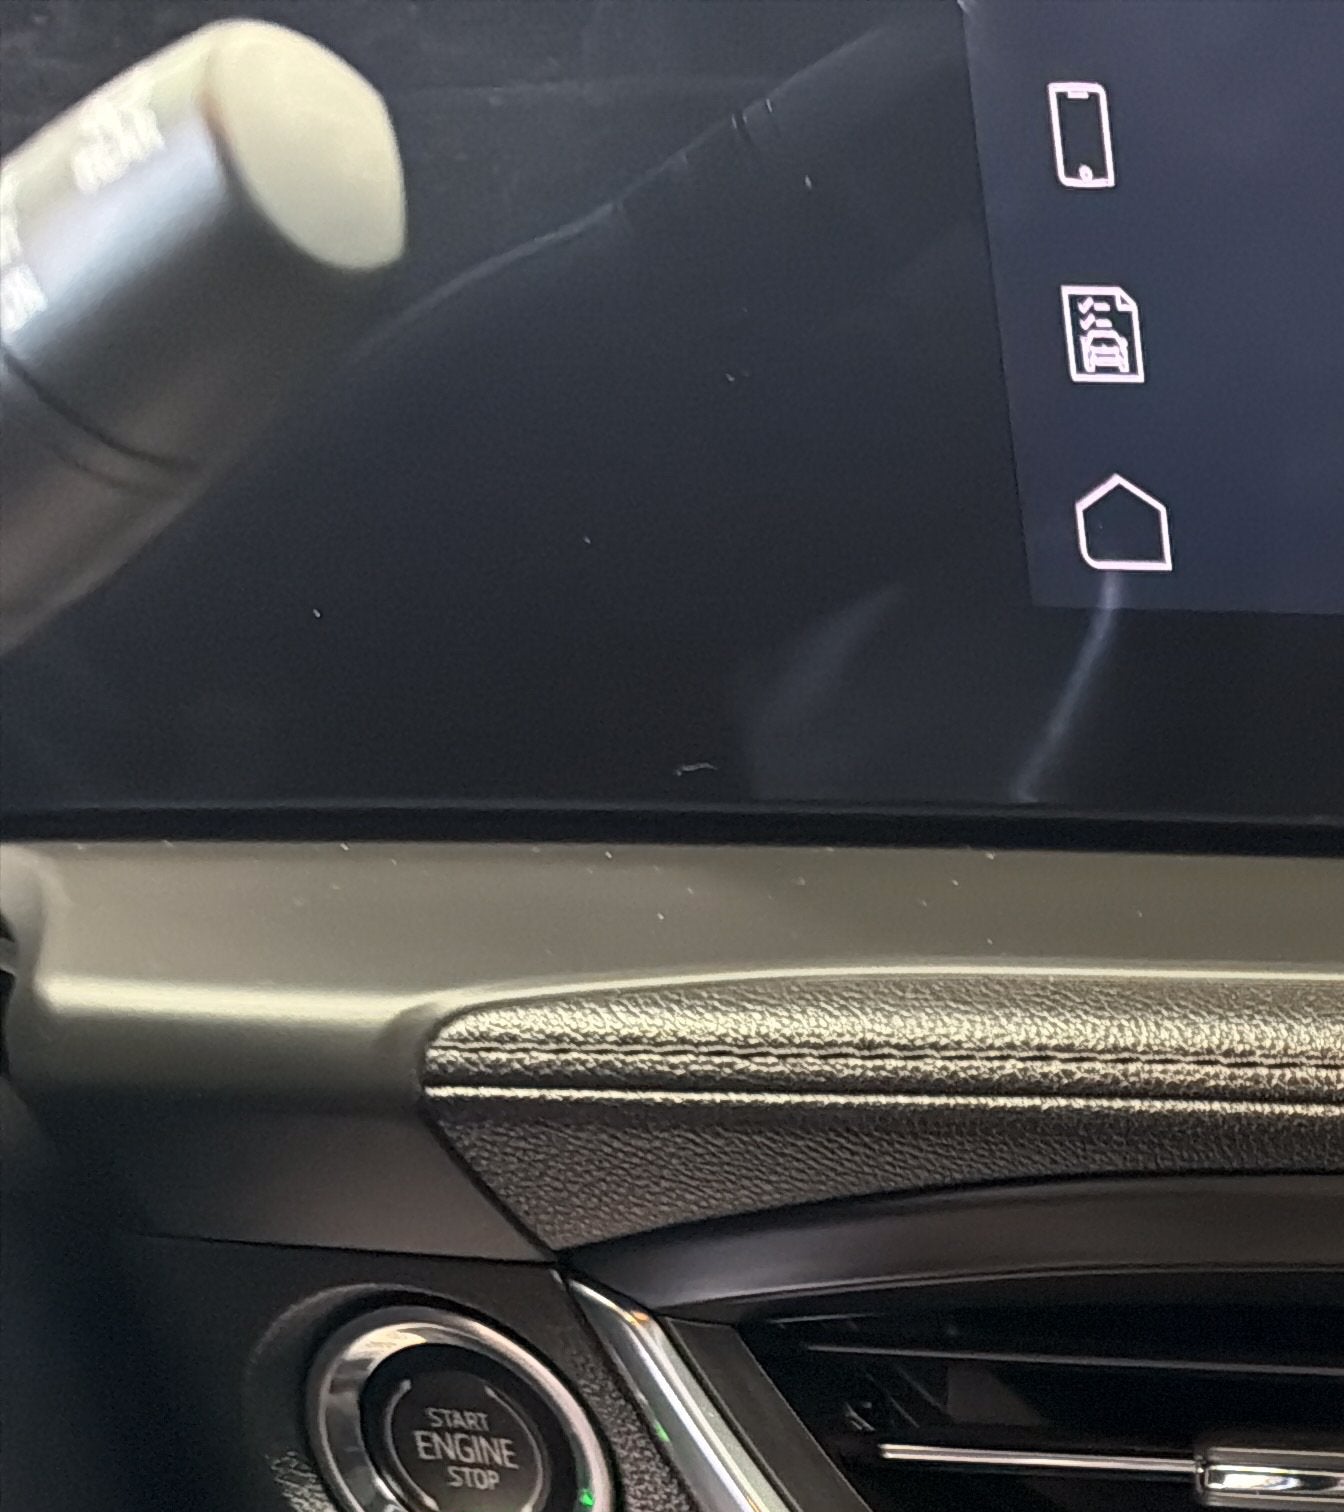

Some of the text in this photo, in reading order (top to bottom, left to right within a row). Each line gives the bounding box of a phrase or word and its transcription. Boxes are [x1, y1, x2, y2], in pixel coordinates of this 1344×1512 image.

[425, 1407, 489, 1431] START
[414, 1430, 519, 1469] ENGINE
[447, 1466, 500, 1490] STOP
